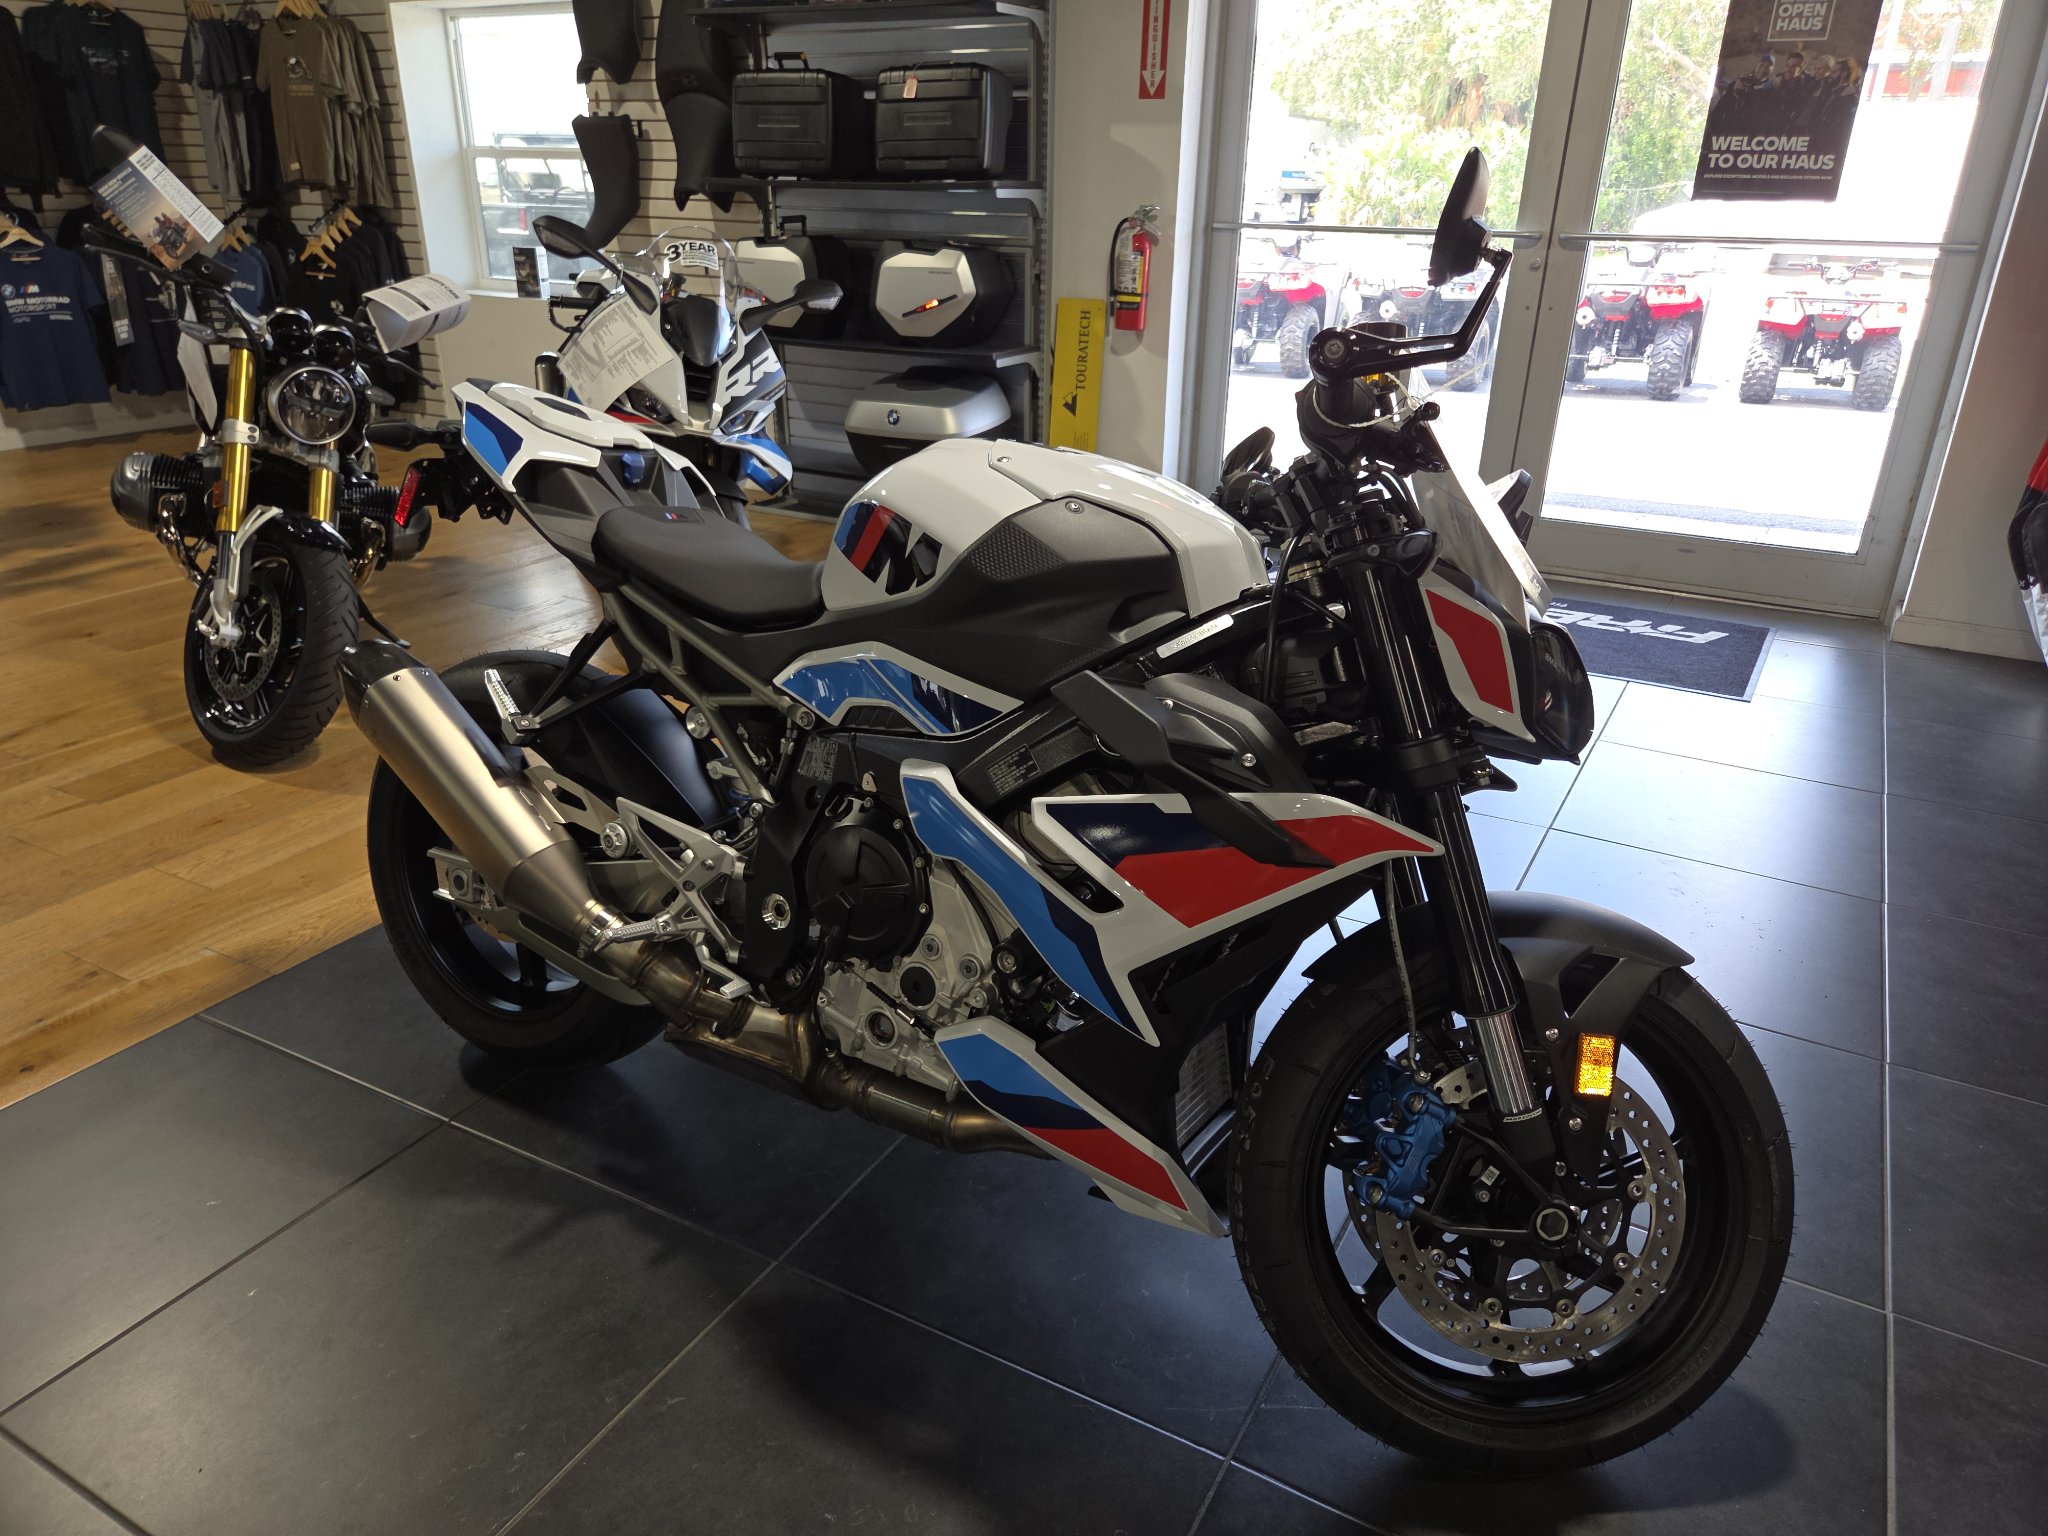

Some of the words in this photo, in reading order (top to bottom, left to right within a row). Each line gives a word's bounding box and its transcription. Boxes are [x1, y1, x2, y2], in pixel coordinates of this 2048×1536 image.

[1778, 3, 1828, 17] OPEN
[1775, 17, 1823, 32] HAUS
[1711, 136, 1810, 151] WELCOME
[1708, 153, 1734, 168] TO
[1736, 154, 1779, 169] OUR
[1781, 154, 1836, 170] HAUS
[666, 244, 681, 262] 3
[680, 242, 716, 256] YEAR
[26, 296, 71, 305] MOTORRAD
[1075, 310, 1092, 391] TOURATECH
